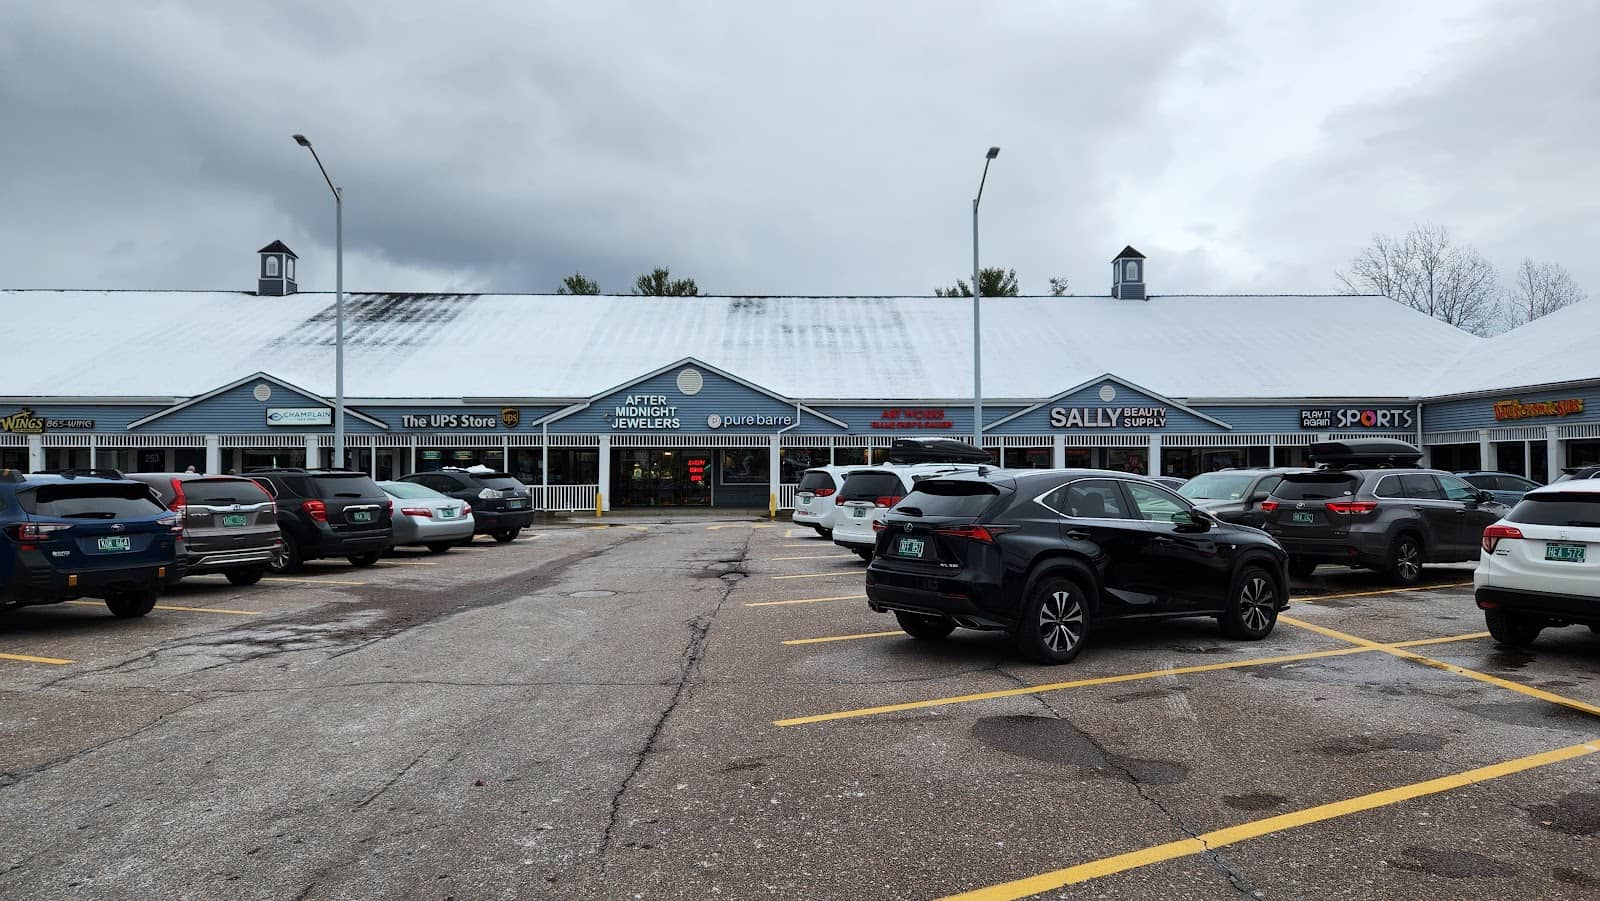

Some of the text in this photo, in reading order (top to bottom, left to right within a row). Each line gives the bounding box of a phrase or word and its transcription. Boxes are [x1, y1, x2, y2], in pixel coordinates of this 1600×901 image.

[625, 395, 667, 405] AFTER
[615, 406, 677, 417] MIDNIGHT
[1051, 407, 1122, 427] SALLY
[1123, 407, 1167, 417] BEAUTY
[1302, 410, 1332, 419] PLAY IT
[1, 414, 43, 432] WINGS
[402, 415, 496, 428] The UPS Store
[611, 418, 681, 429] JEWELERS
[724, 413, 792, 428] pure barre
[1124, 418, 1167, 428] SUPPLY
[1303, 419, 1330, 427] AGAIN
[1337, 408, 1412, 428] SPORTS
